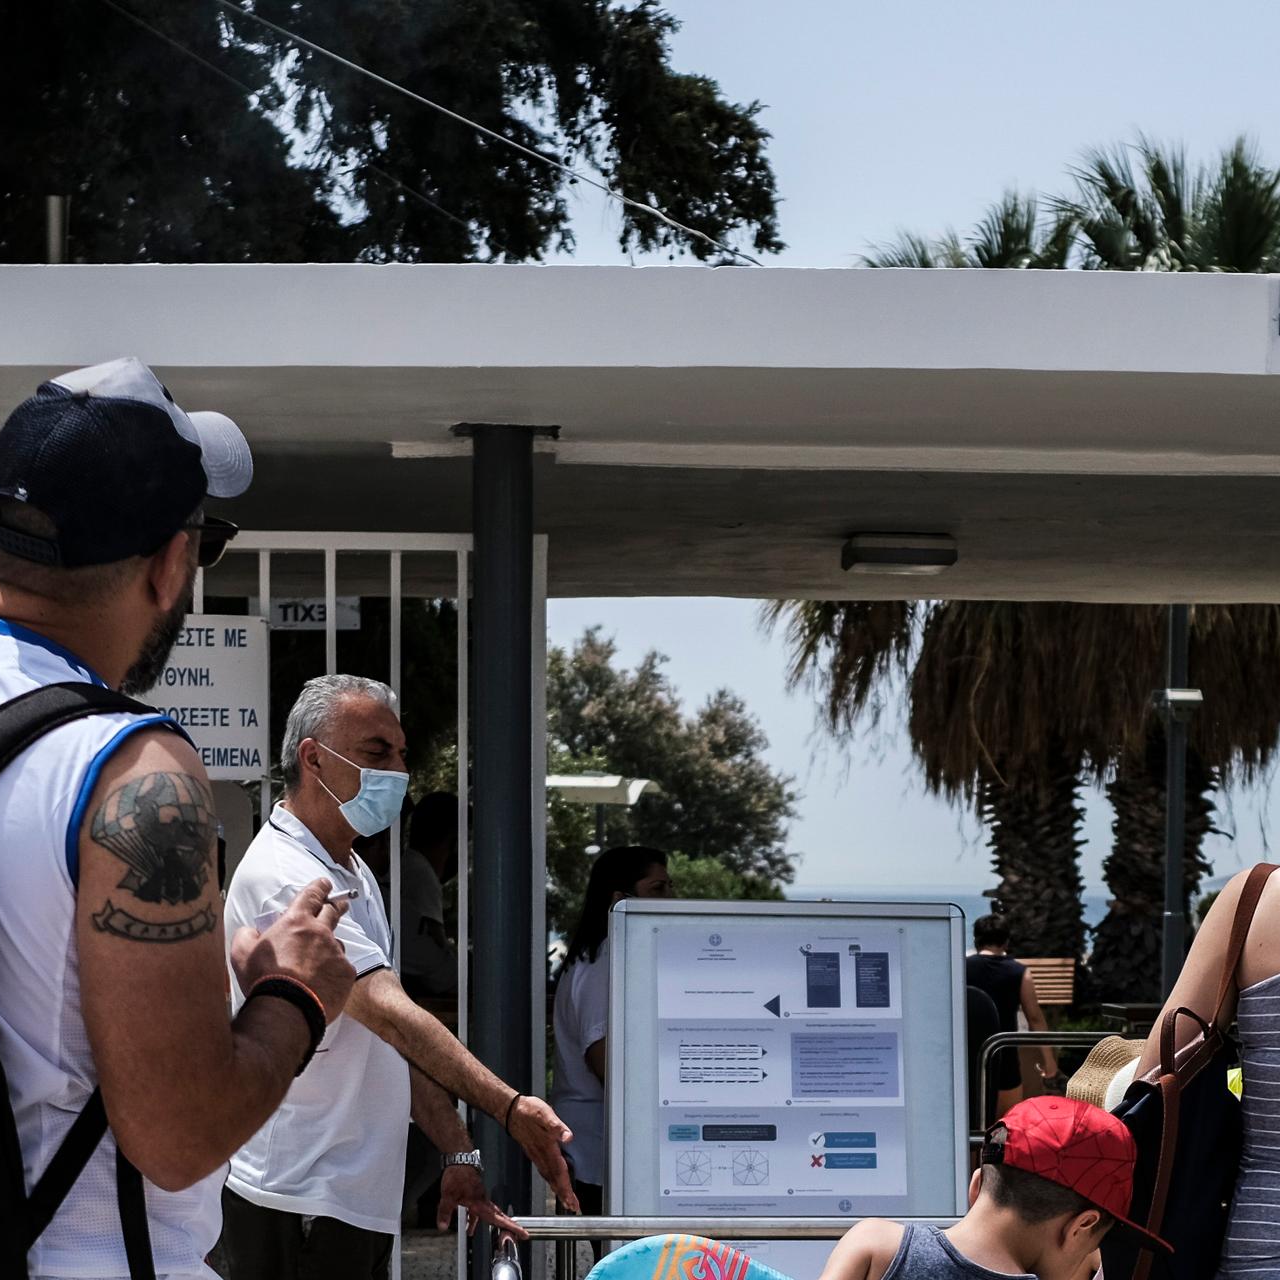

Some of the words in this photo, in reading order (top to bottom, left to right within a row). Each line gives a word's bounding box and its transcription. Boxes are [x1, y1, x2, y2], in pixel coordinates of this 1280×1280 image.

[176, 628, 215, 646] ΕΣΤΕ
[224, 628, 247, 647] ΜΕ
[158, 668, 214, 686] ΥΘΥΝΗ.
[158, 707, 230, 726] ΟΣΕΞΤΕ
[239, 708, 258, 727] ΤΑ
[197, 748, 261, 767] ΕΙΜΕΝΑ
